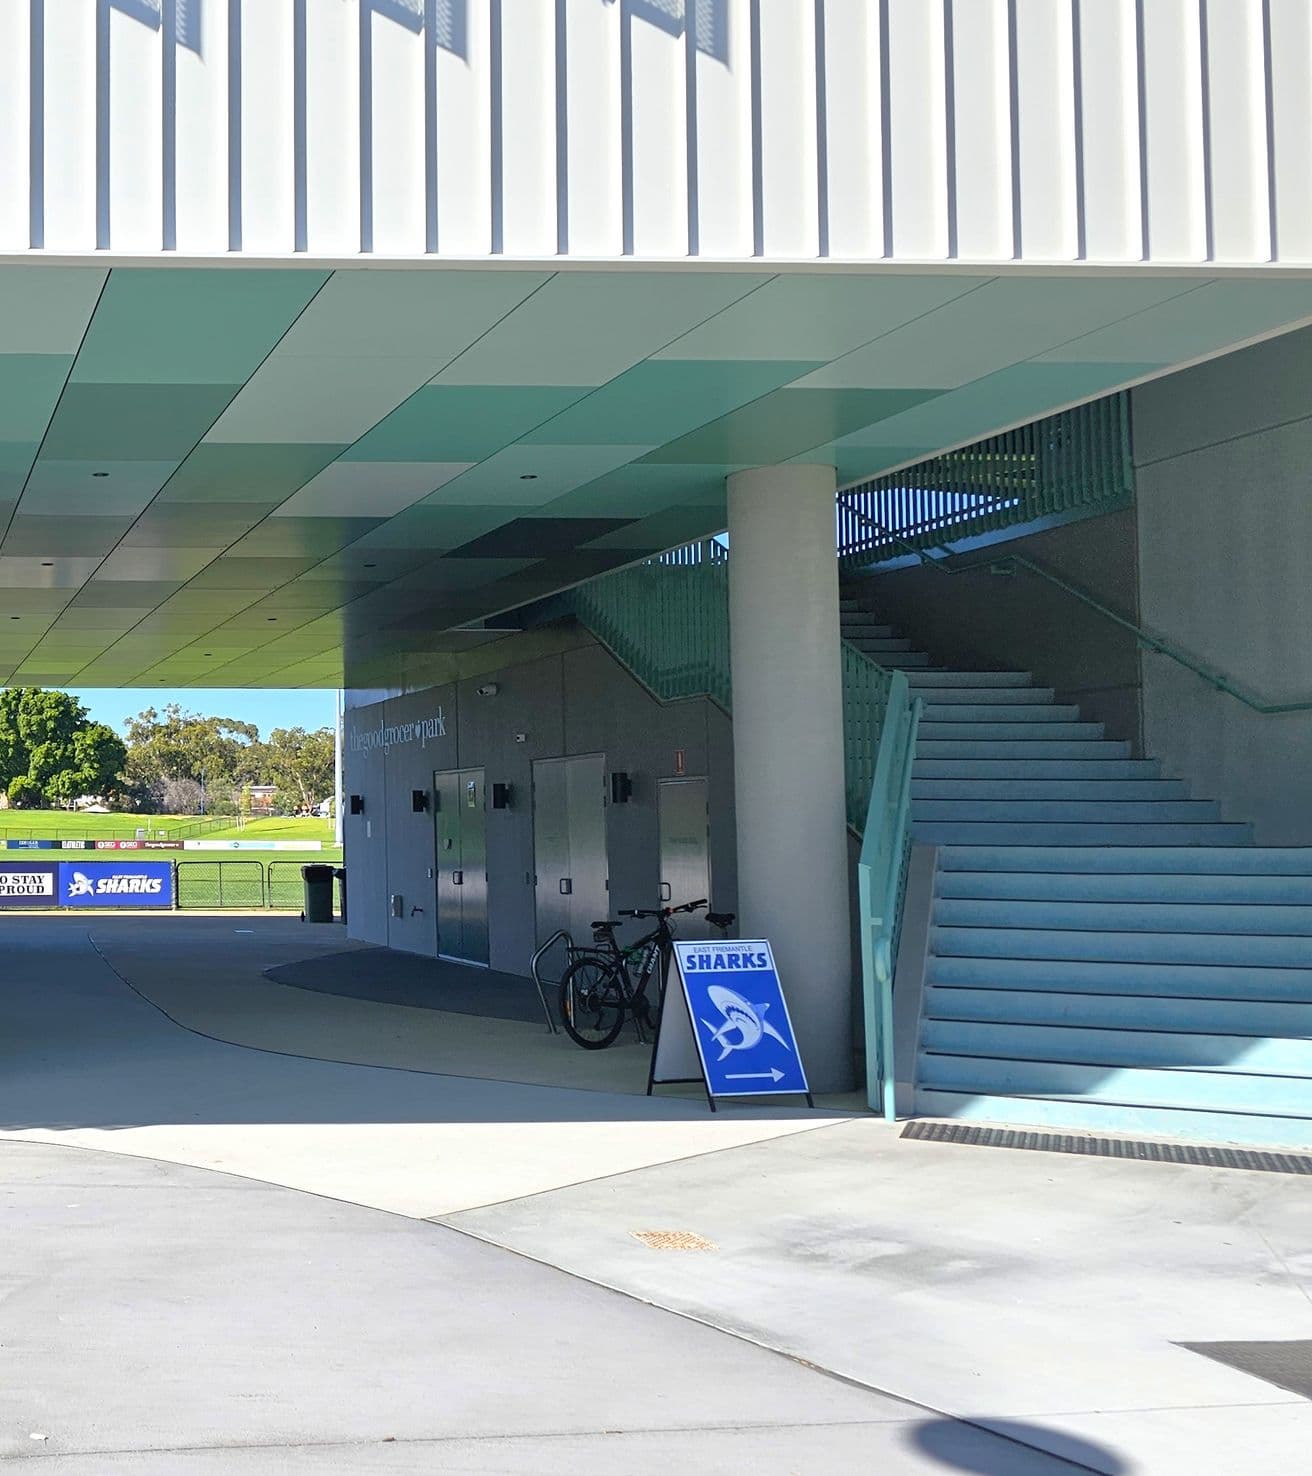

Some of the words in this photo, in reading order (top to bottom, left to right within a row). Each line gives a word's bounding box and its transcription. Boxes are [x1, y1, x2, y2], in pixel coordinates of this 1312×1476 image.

[421, 706, 446, 749] park
[11, 875, 45, 885] STAY
[95, 878, 163, 894] SHARKS
[693, 946, 711, 954] EAST
[711, 945, 753, 953] FREMANTLE
[686, 952, 768, 971] SHARKS
